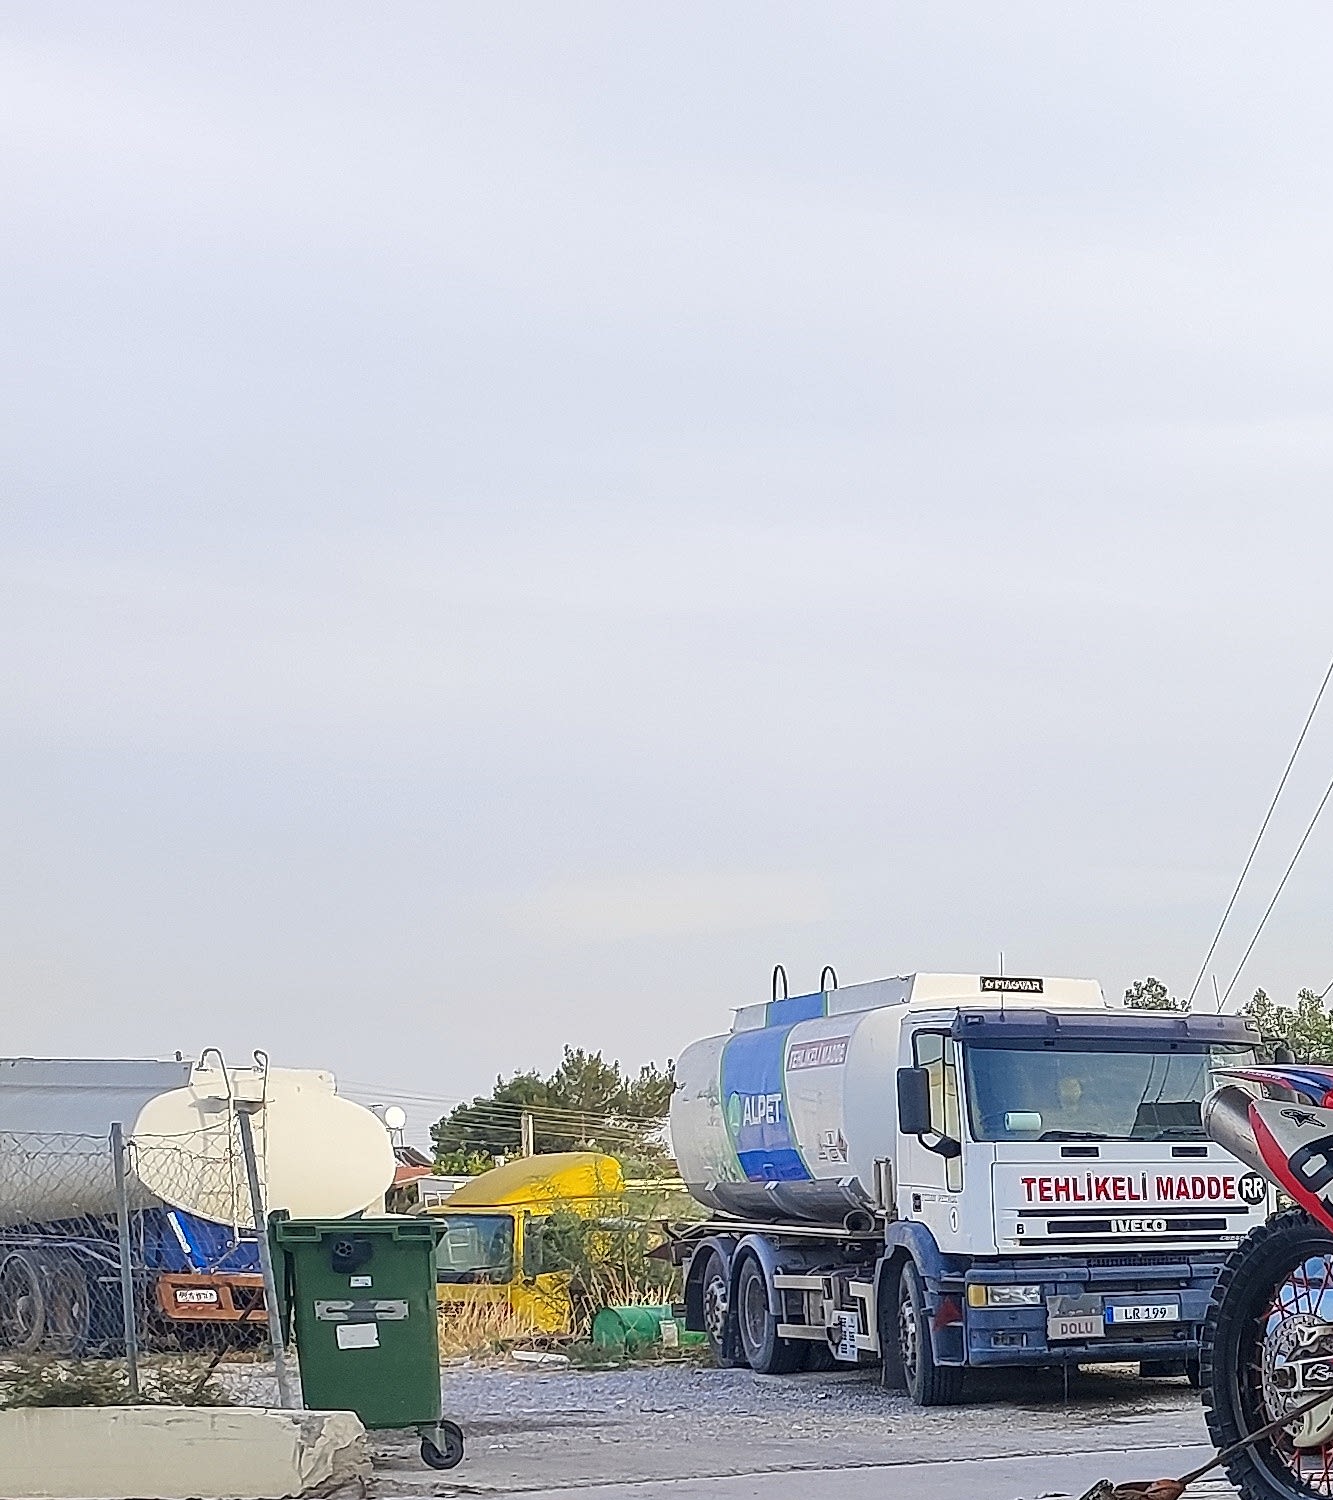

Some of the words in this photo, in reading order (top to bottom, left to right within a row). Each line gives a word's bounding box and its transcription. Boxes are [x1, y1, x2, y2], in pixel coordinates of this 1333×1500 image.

[742, 1093, 782, 1127] ALPET
[1156, 1176, 1236, 1201] MADDE
[1241, 1177, 1264, 1200] RR
[1110, 1218, 1167, 1232] IVECO
[1124, 1308, 1141, 1320] LR
[1144, 1307, 1167, 1319] 199
[1060, 1322, 1093, 1335] DOLU
